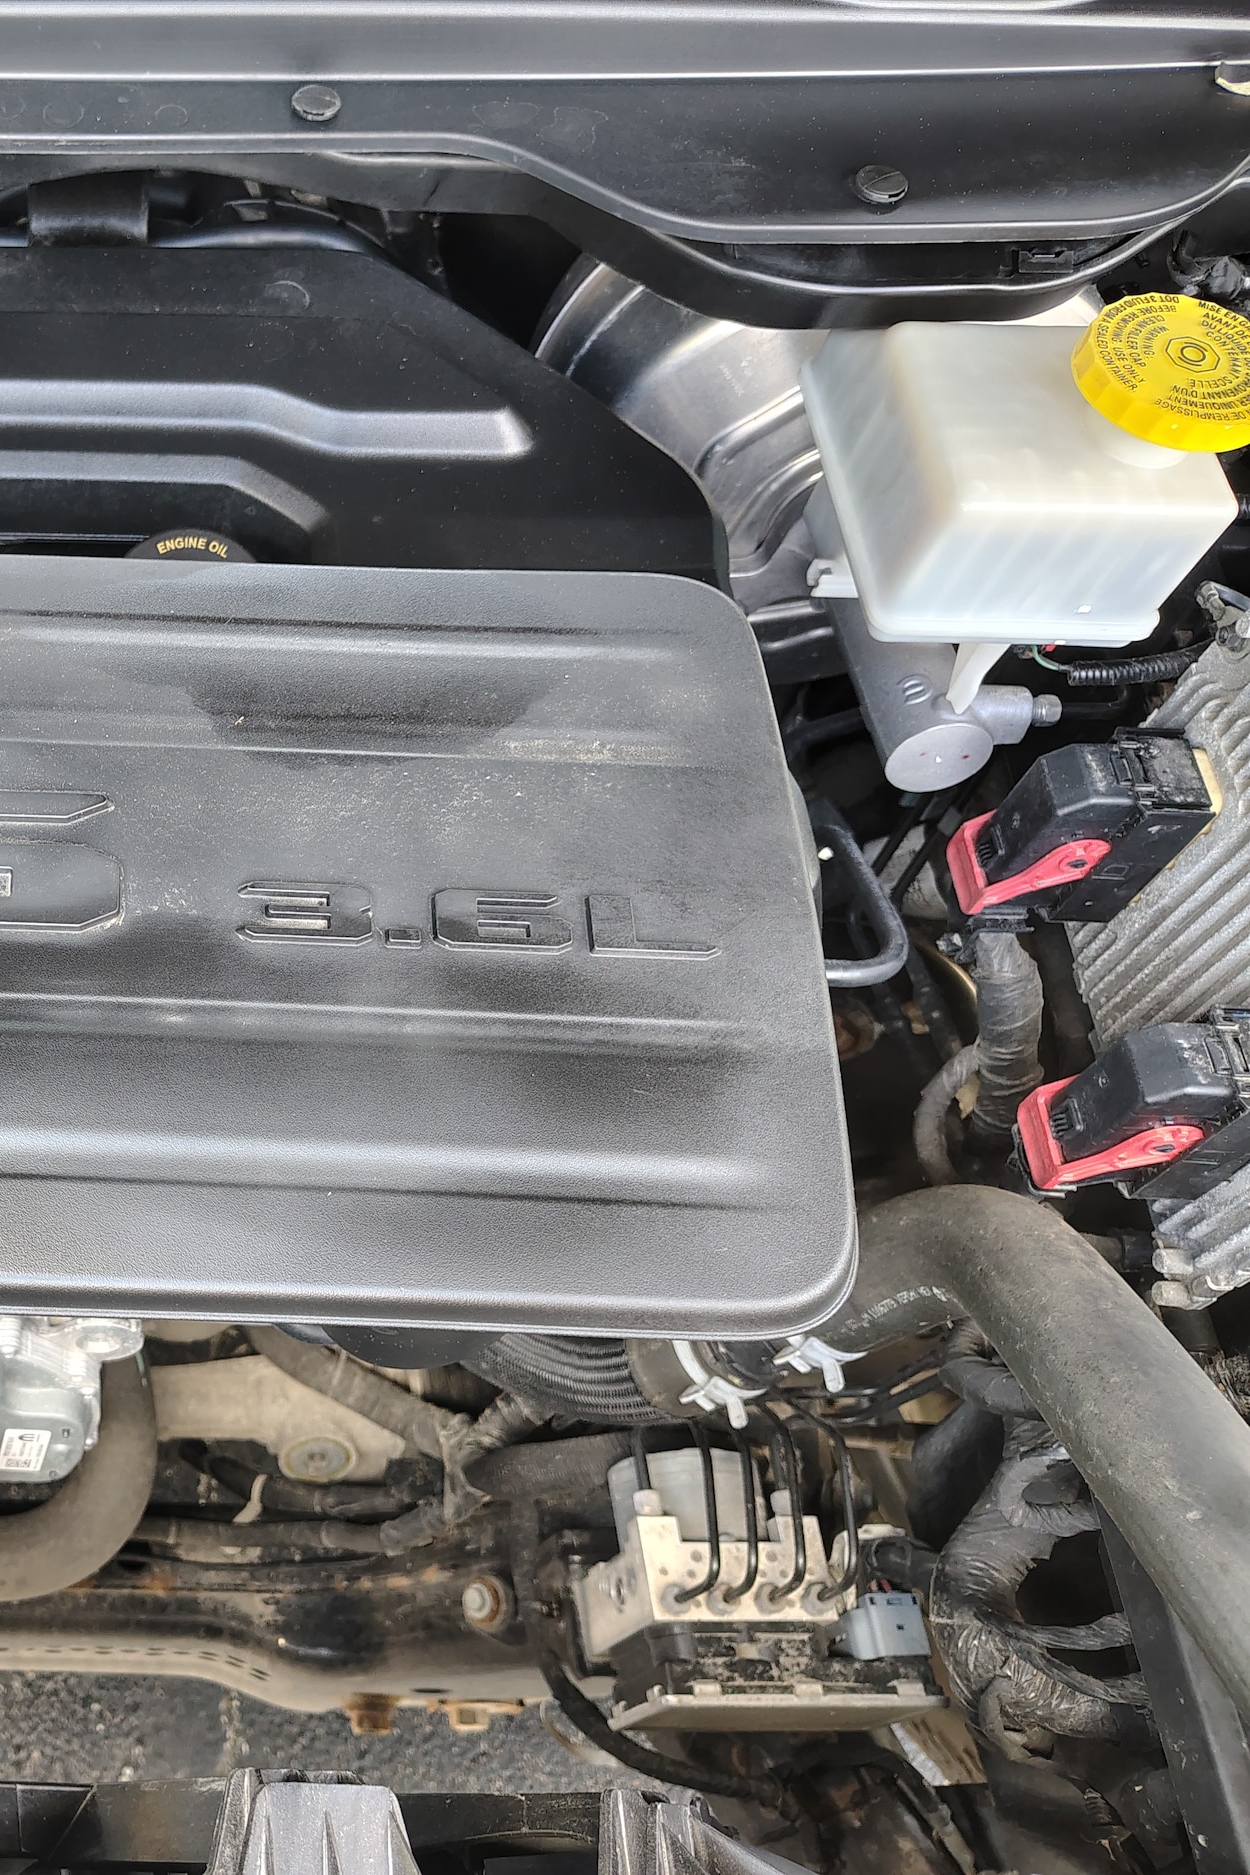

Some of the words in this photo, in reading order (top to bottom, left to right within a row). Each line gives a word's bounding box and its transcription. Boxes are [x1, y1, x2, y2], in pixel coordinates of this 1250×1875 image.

[1124, 297, 1150, 308] FLUID
[1149, 295, 1157, 303] 3
[1159, 295, 1179, 304] DOT
[1103, 303, 1127, 320] FROM
[1137, 304, 1177, 316] BEFORE
[1198, 301, 1223, 315] MISE
[1223, 311, 1240, 322] EN
[1136, 314, 1165, 330] CLEAN
[1201, 320, 1217, 330] DU
[1202, 312, 1238, 331] AVANT
[1096, 323, 1110, 350] SEALED
[1126, 326, 1142, 351] FILLER
[1113, 347, 1128, 362] USE
[1129, 352, 1146, 368] CAP
[1122, 364, 1146, 384] ONLY
[1172, 385, 1198, 399] D'UN
[1154, 398, 1231, 421] REMPLISSAGE
[1167, 394, 1239, 411] UNIQUEMENT
[1230, 411, 1247, 421] DE
[156, 537, 207, 555] ENGINE
[208, 541, 228, 558] OIL
[236, 881, 722, 960] 3.6L
